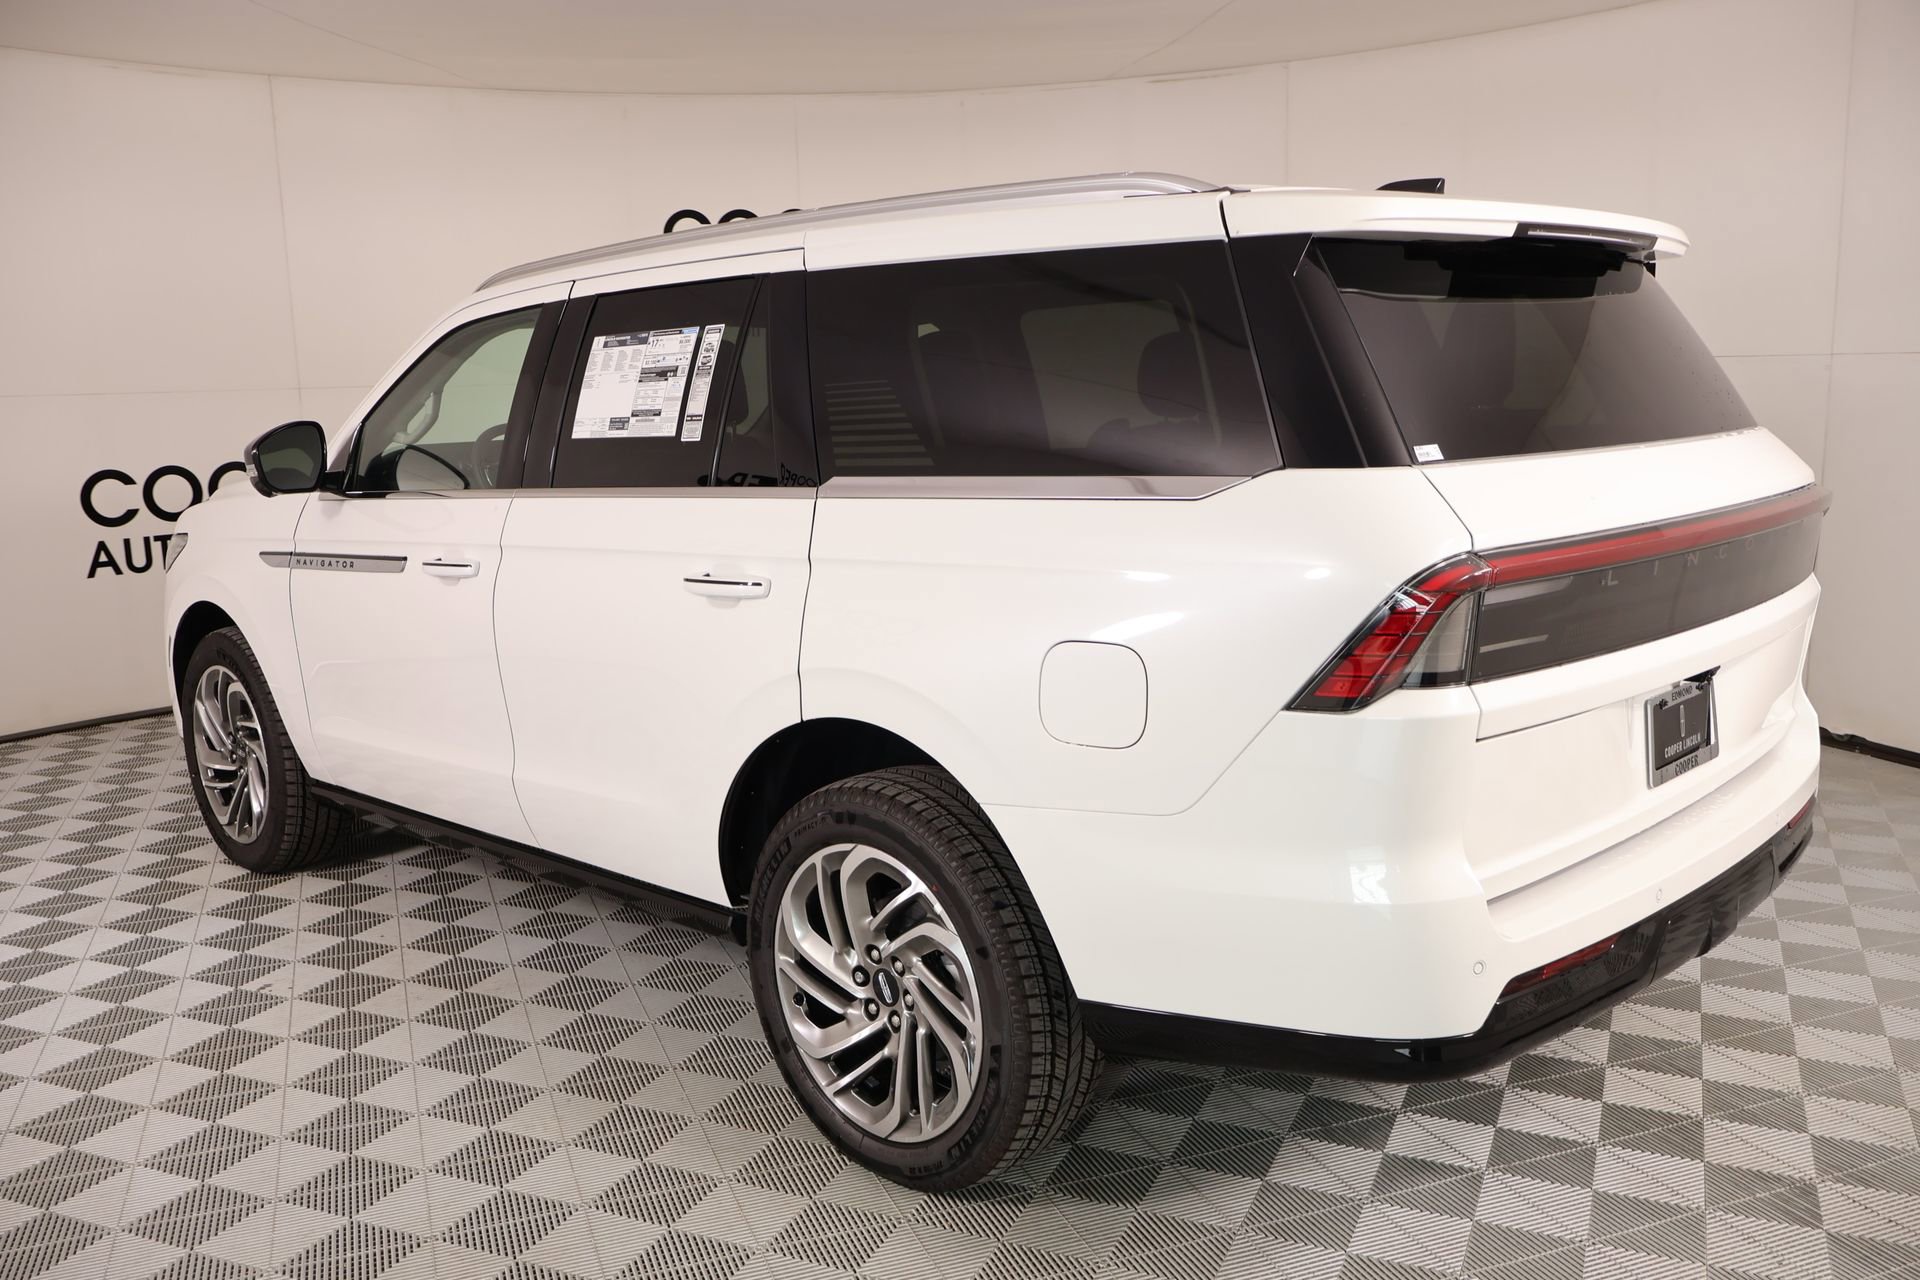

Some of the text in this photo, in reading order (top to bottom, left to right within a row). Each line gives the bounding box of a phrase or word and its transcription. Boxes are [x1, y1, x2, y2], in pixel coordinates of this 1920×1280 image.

[295, 559, 355, 569] NAVIGATOR
[1672, 685, 1693, 700] EDMOND
[1665, 733, 1701, 758] COOPER LINCOLN
[1674, 754, 1699, 776] COOPER
[948, 1072, 999, 1161] MICHELIN
